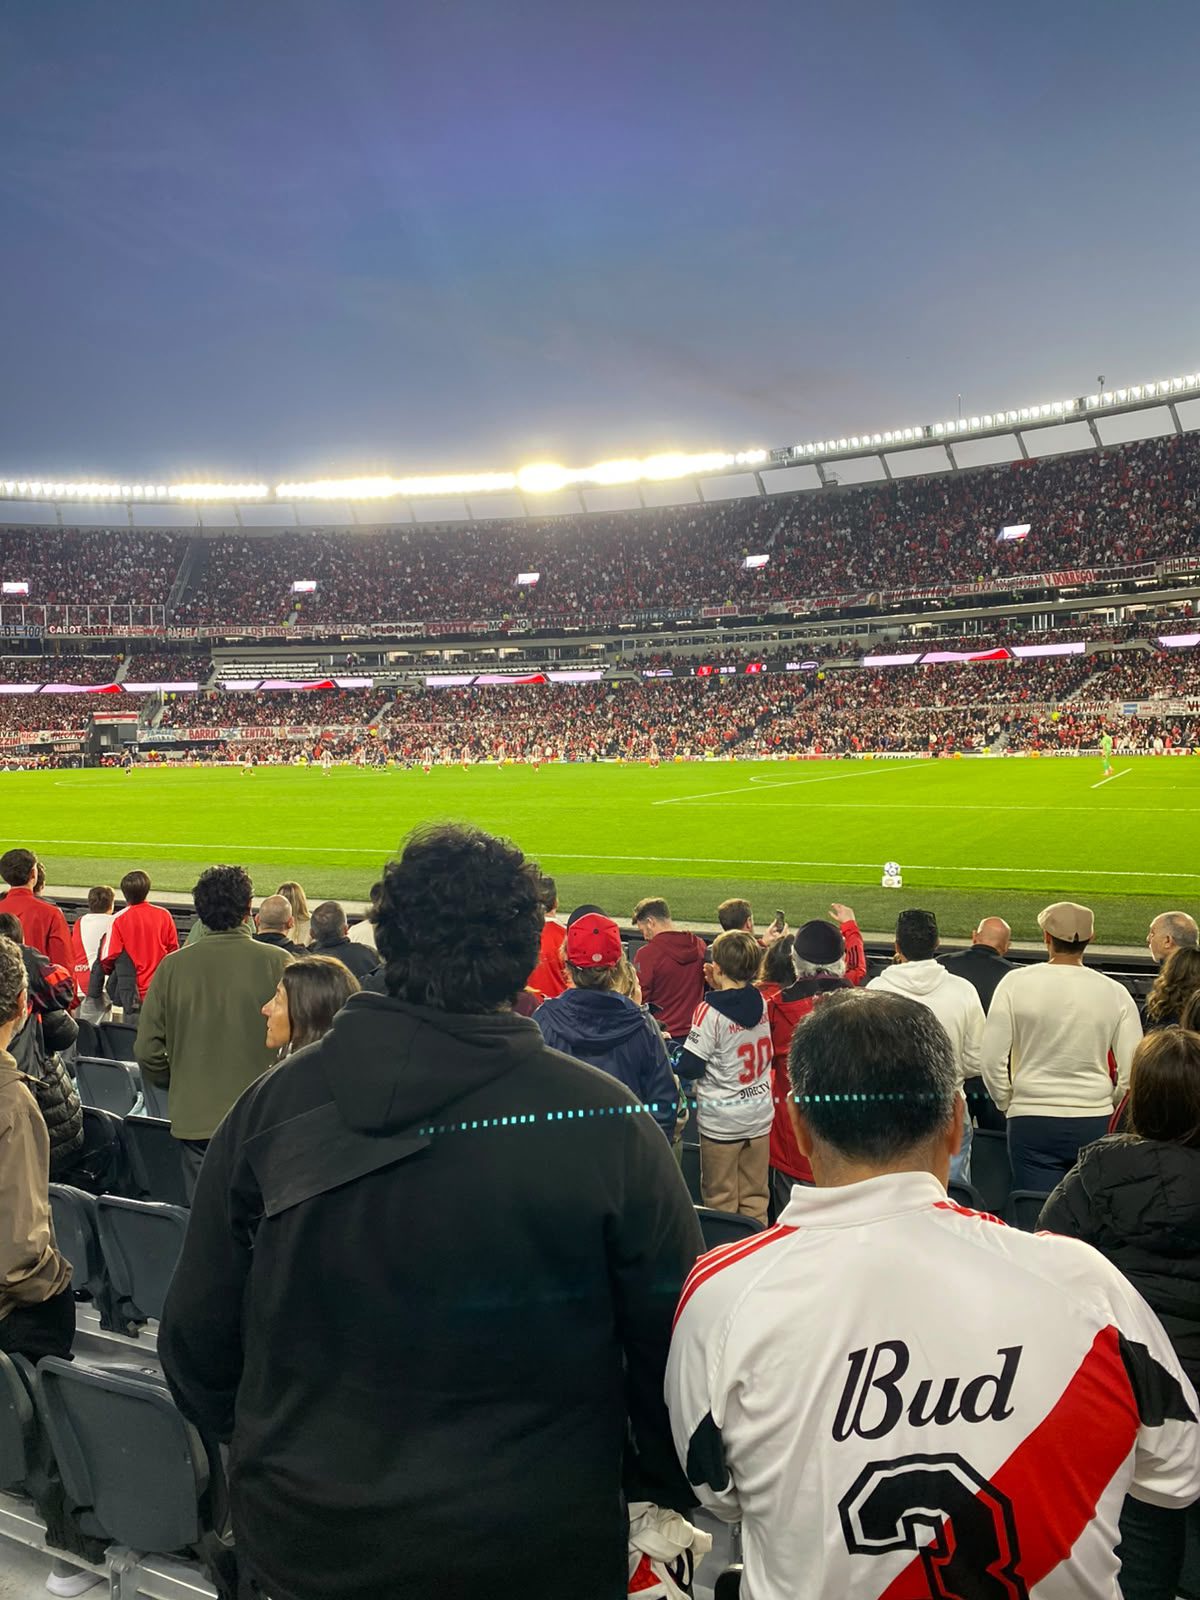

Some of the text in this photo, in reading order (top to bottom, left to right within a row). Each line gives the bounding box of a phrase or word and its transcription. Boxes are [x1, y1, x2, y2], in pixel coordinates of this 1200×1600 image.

[208, 627, 243, 636] BARRIO
[245, 627, 264, 637] LOS
[188, 729, 220, 740] BARRIO
[240, 727, 275, 738] CENTRAL
[737, 1036, 771, 1085] 30
[832, 1340, 1023, 1442] Bud
